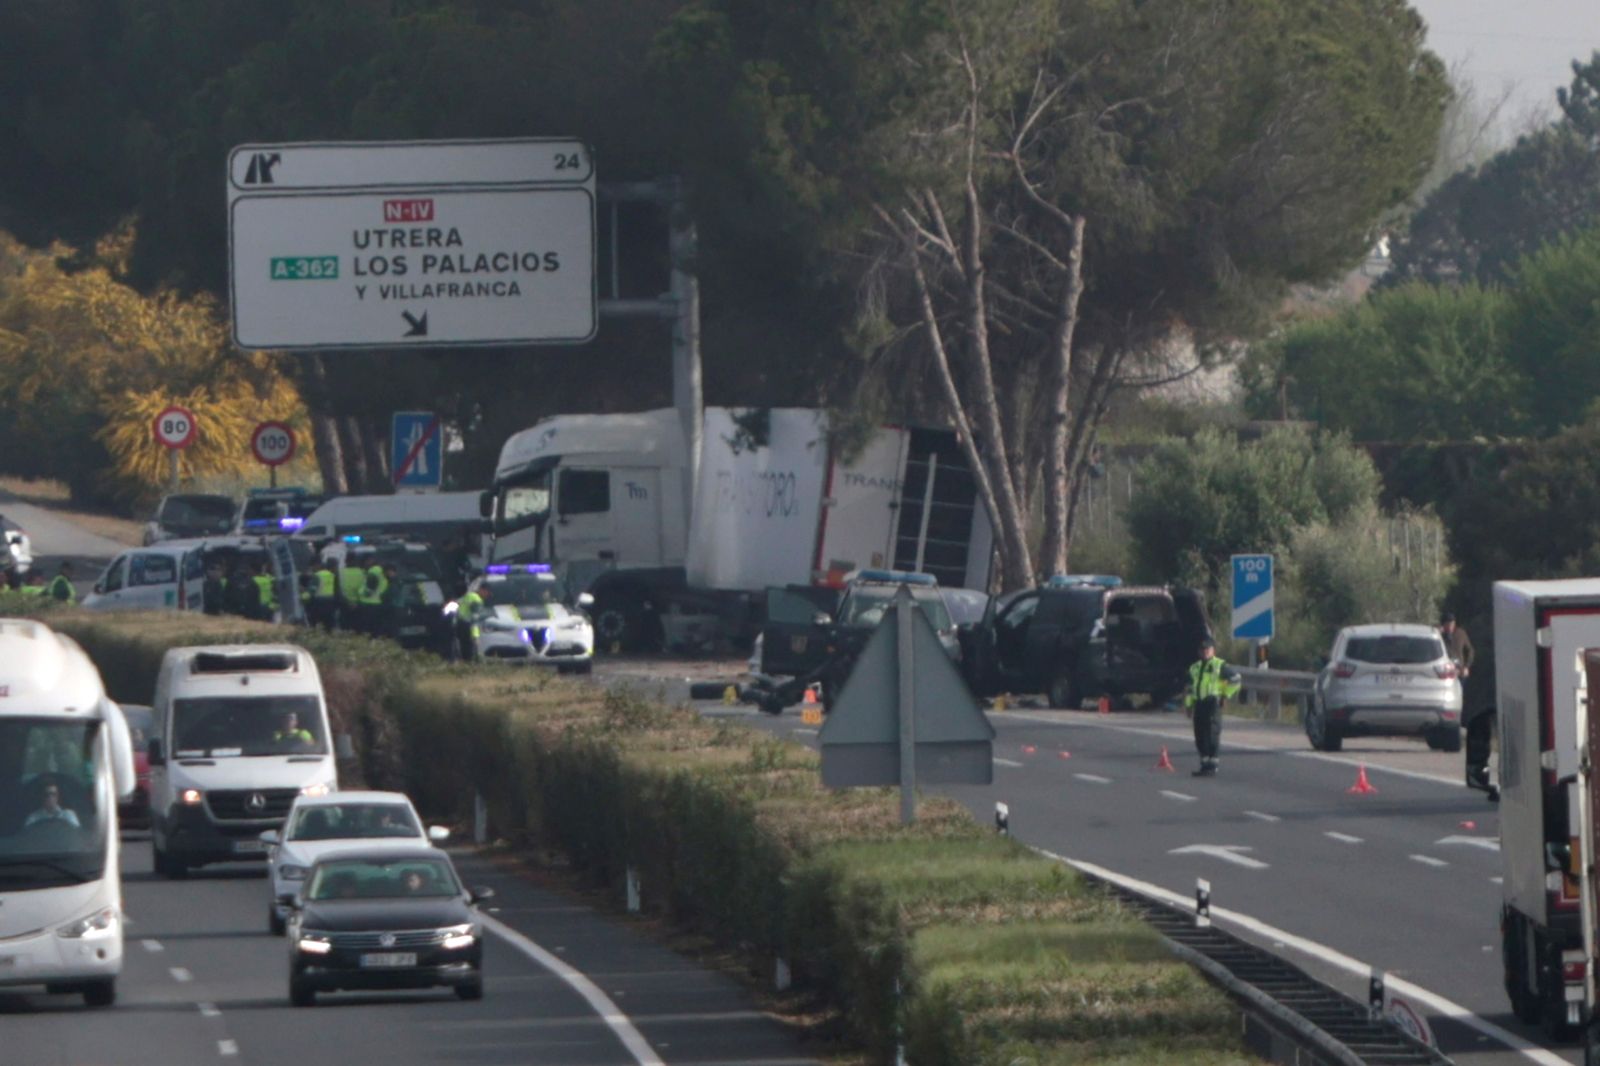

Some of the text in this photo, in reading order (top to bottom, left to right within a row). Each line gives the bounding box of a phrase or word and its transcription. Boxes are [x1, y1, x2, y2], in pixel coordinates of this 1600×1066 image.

[553, 153, 580, 170] 24
[386, 202, 431, 219] N-IV
[353, 228, 463, 250] UTRERA
[273, 258, 337, 278] A-362
[354, 251, 560, 276] LOS PALACIOS
[356, 281, 521, 300] Y VILLAFRANCA
[163, 420, 187, 434] 80
[261, 435, 288, 450] 100
[1239, 559, 1265, 572] 100
[1246, 573, 1258, 583] m
